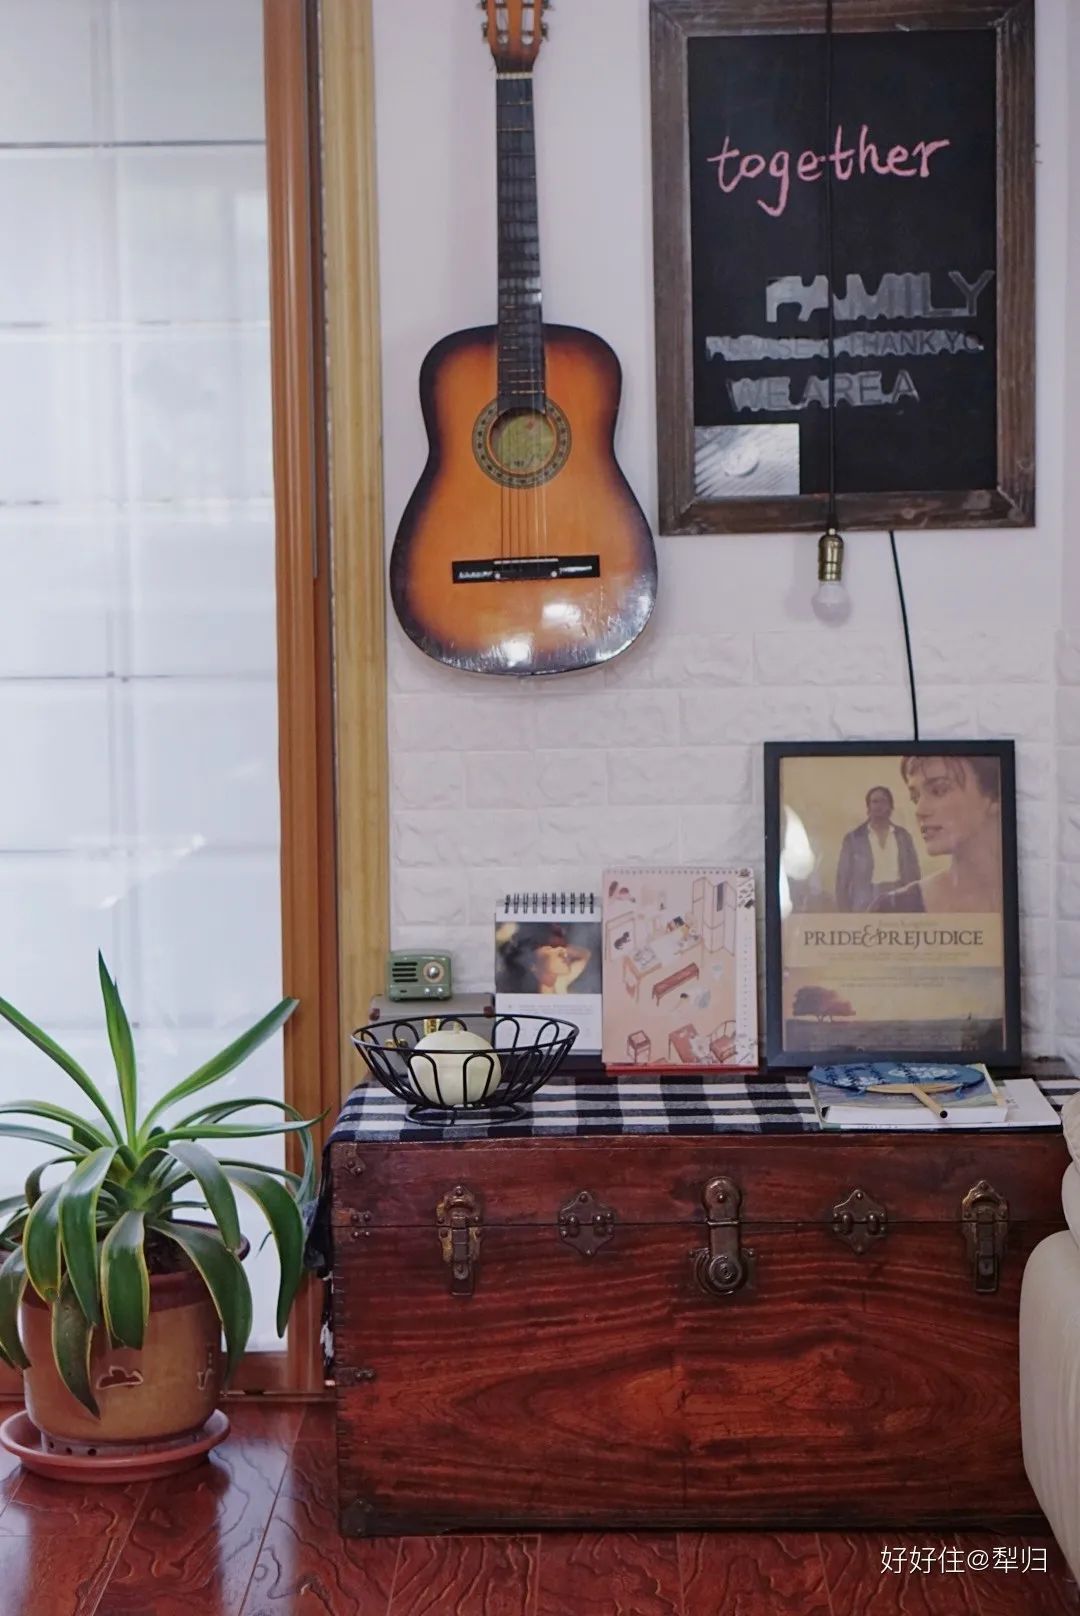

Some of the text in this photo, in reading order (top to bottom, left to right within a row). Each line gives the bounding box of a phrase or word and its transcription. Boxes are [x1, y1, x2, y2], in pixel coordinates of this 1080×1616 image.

[707, 125, 950, 217] together
[727, 368, 920, 412] WE ARE A
